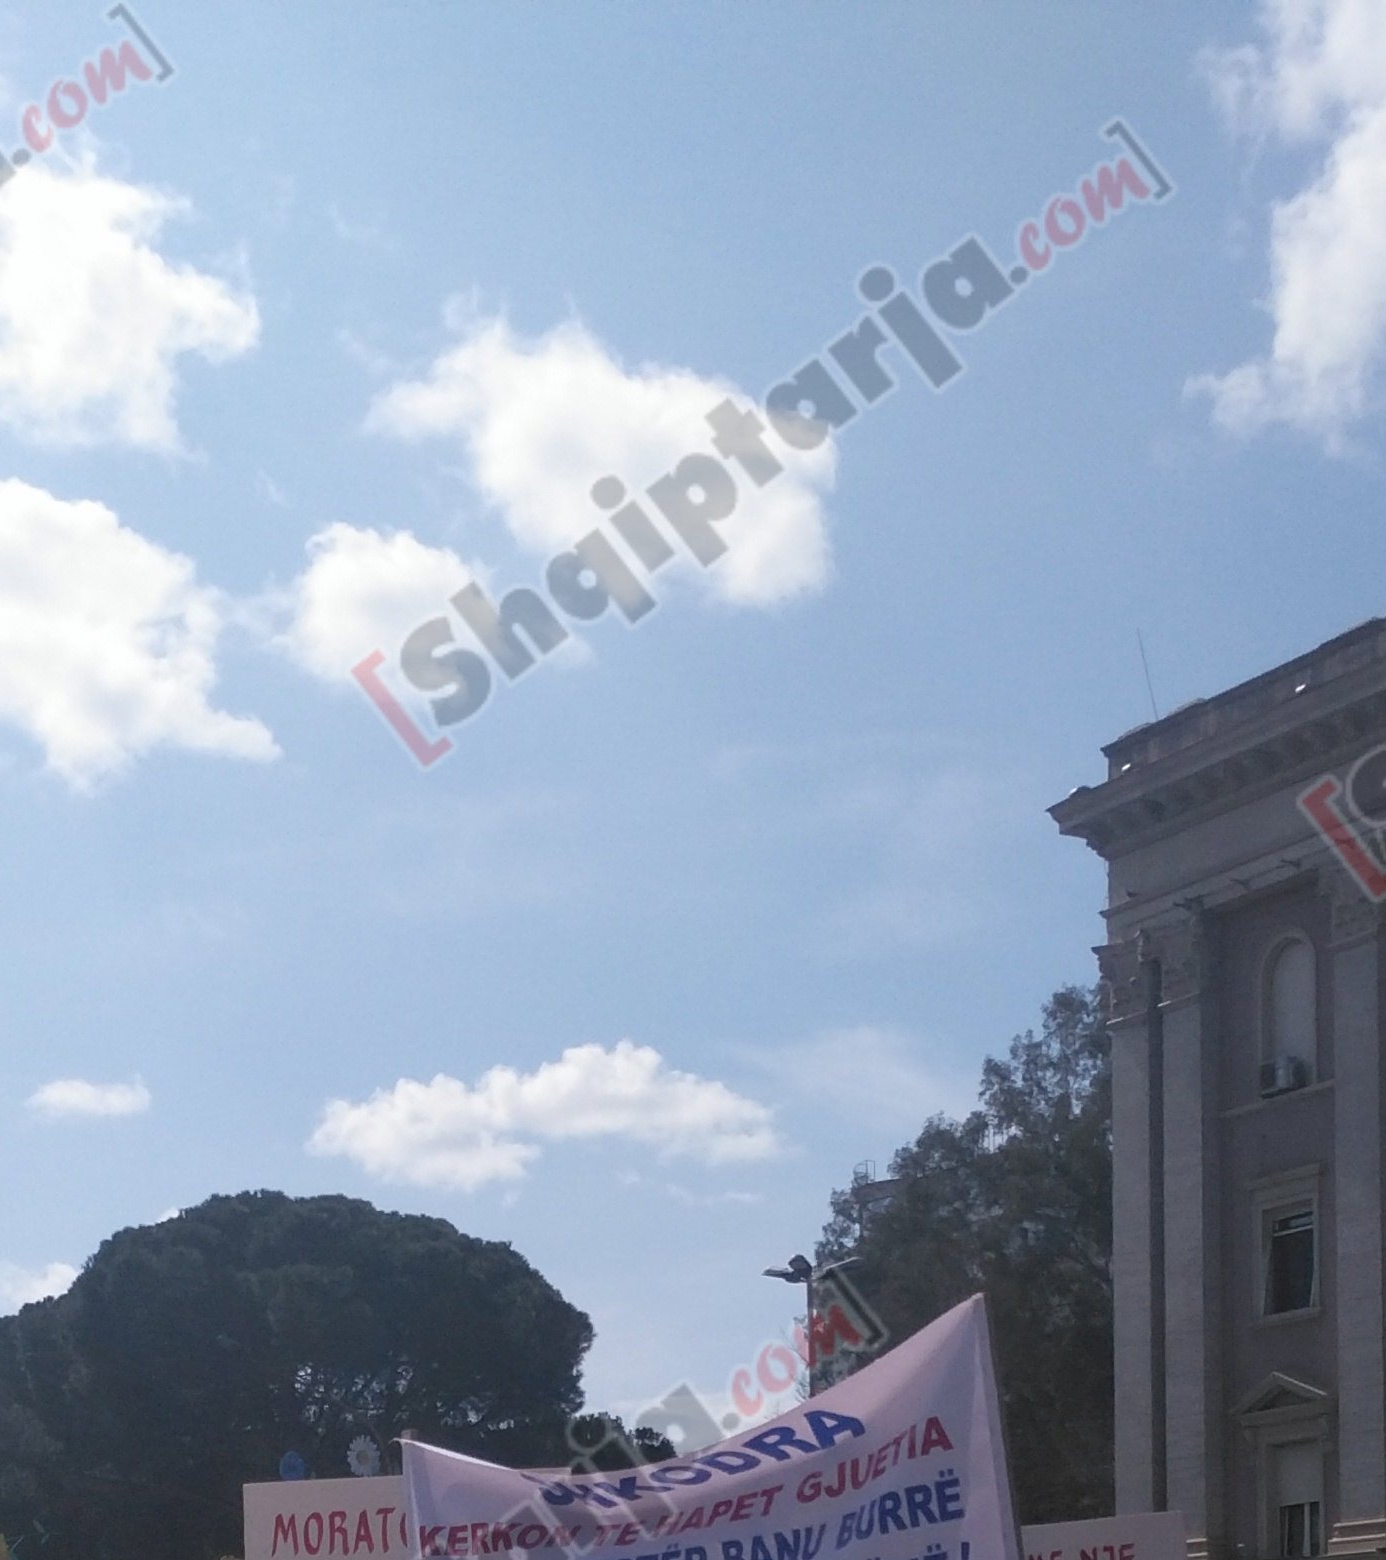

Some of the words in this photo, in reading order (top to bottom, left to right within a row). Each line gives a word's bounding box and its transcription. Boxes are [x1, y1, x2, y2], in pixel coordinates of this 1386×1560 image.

[419, 1521, 581, 1558] KERKON
[595, 1522, 641, 1547] TE
[654, 1483, 784, 1538] HAPET
[796, 1415, 954, 1504] GJUETIA
[835, 1468, 966, 1550] BURRË
